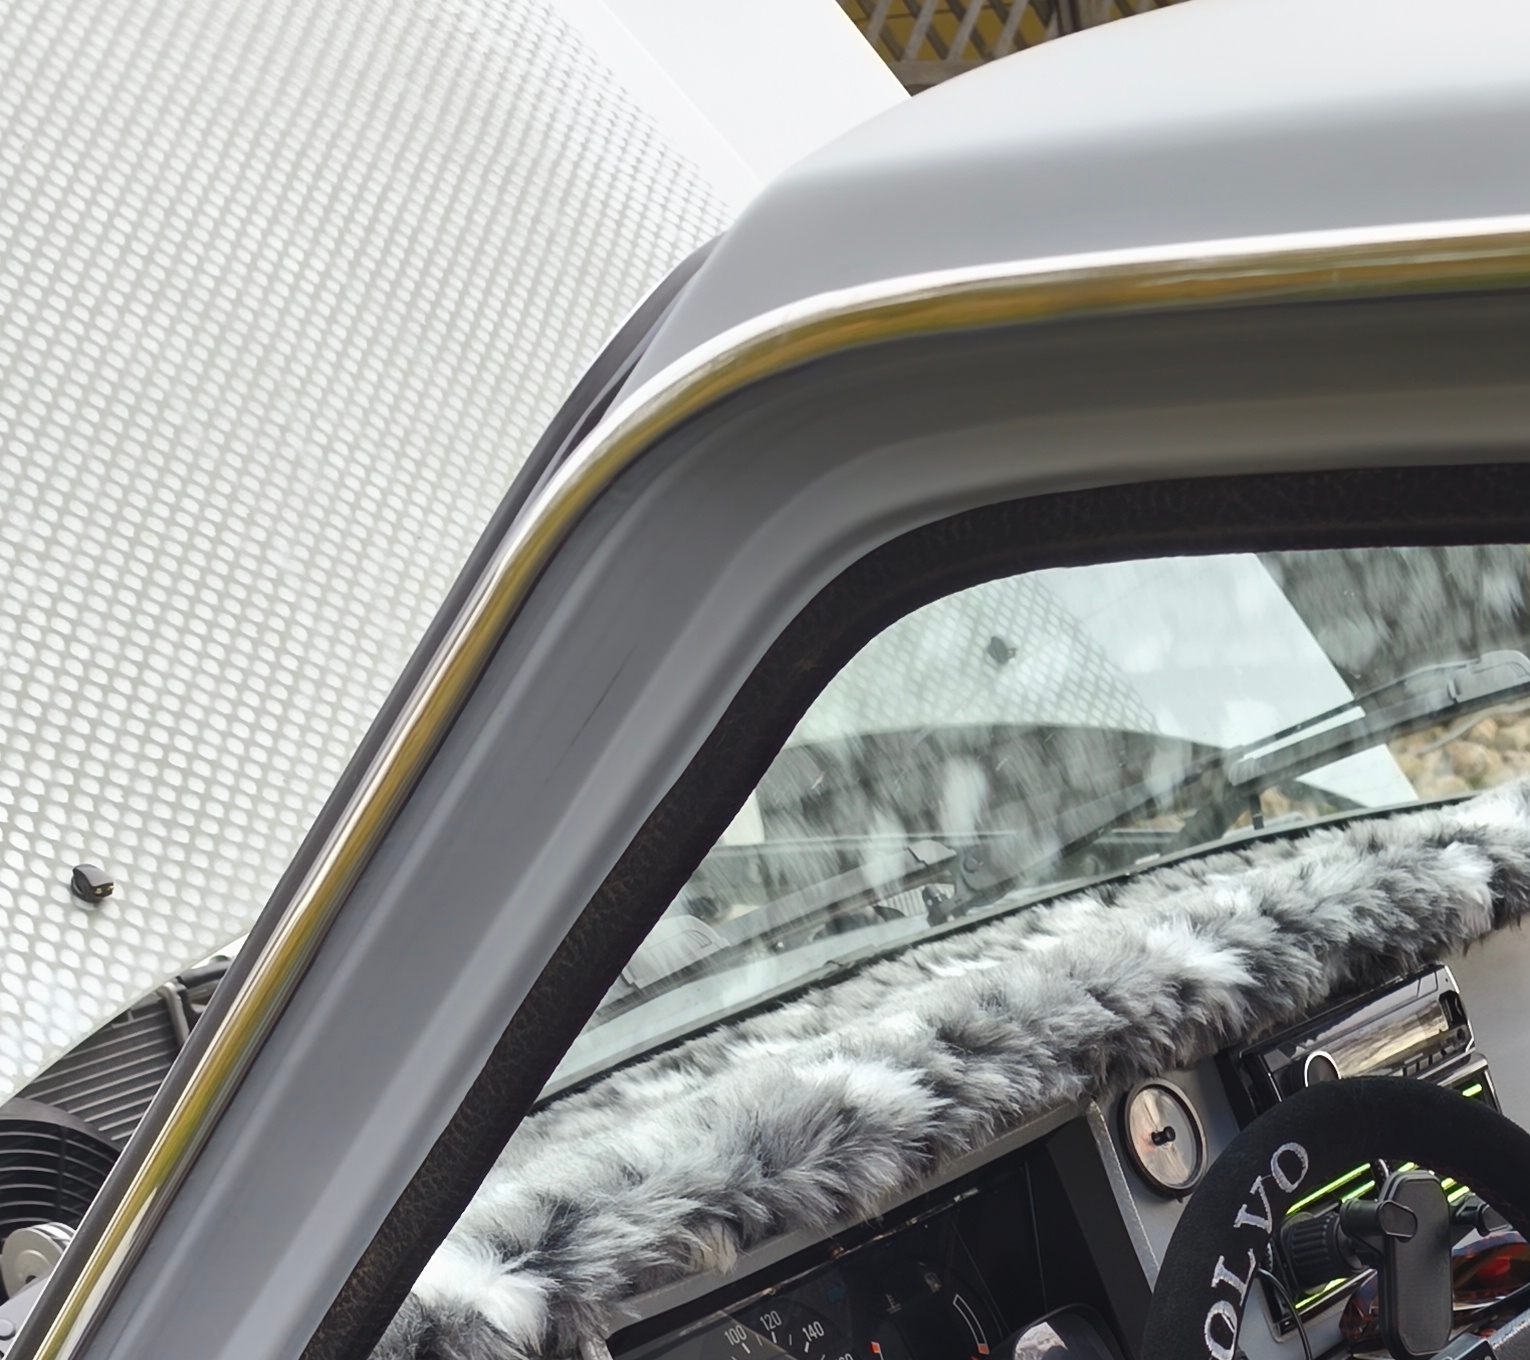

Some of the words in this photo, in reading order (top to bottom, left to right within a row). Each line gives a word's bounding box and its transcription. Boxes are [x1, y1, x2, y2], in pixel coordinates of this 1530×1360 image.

[760, 1310, 783, 1332] 120
[802, 1321, 825, 1342] 140
[724, 1324, 748, 1346] 100
